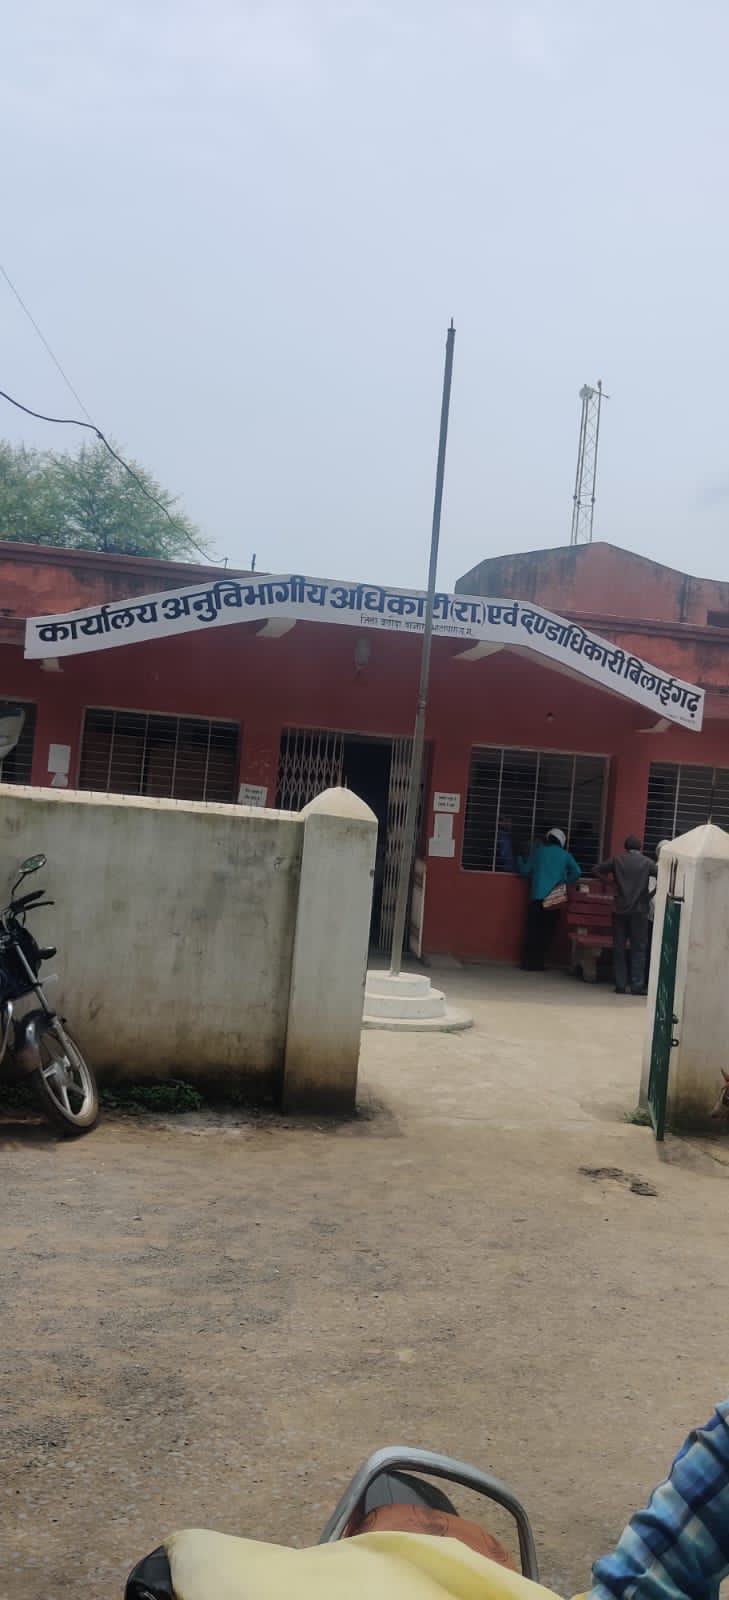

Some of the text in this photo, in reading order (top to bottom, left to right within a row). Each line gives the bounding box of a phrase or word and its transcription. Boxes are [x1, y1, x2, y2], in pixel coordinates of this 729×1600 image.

[36, 602, 158, 643] कार्यालय
[161, 575, 328, 621] अनुविभागीय
[520, 608, 625, 675] दण्डाधिकारी
[623, 656, 701, 718] बिलाईगढ़
